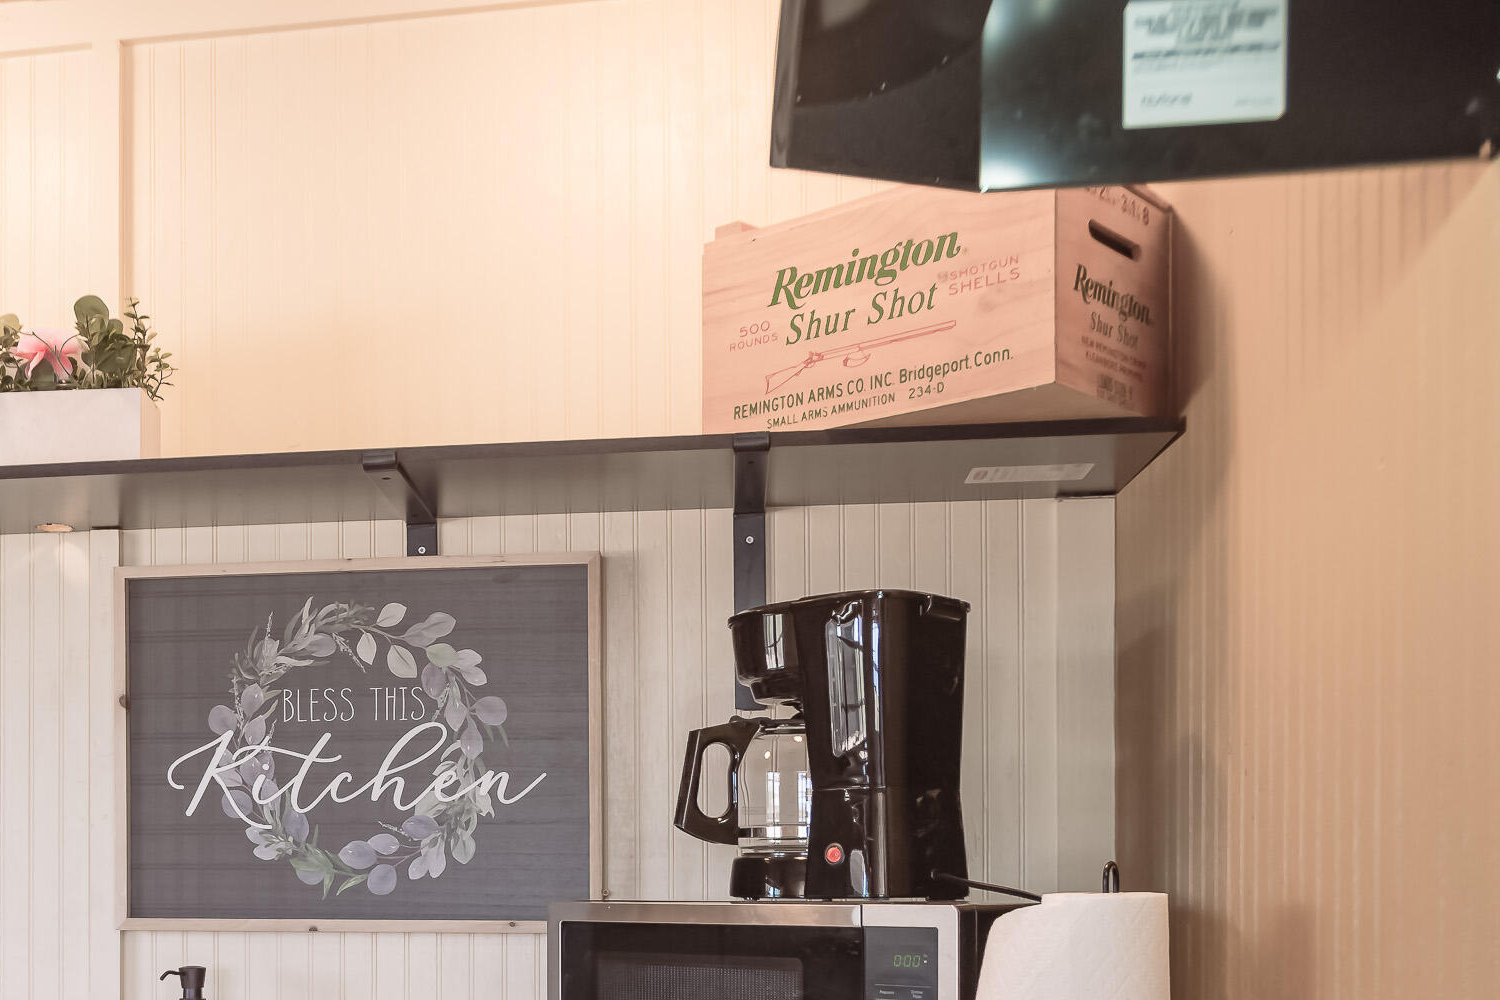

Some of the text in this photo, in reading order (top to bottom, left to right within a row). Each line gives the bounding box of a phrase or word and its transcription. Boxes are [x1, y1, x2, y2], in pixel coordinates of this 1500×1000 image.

[767, 231, 961, 310] Remington
[948, 267, 1020, 296] SHELLS
[949, 255, 1019, 281] SHOTGUN
[1073, 263, 1151, 326] Remington
[739, 320, 770, 338] 500
[786, 282, 938, 346] Shur Shot
[729, 332, 778, 352] ROUNDS
[733, 390, 804, 420] REMINGTON
[807, 381, 844, 403] ARMS
[846, 376, 866, 396] CO.
[974, 347, 1014, 368] Conn.
[767, 413, 798, 430] SMALL
[801, 407, 828, 422] ARMS
[831, 392, 895, 415] AMMUNITION
[282, 686, 427, 723] BLESS THIS
[167, 721, 547, 830] Kitchen
